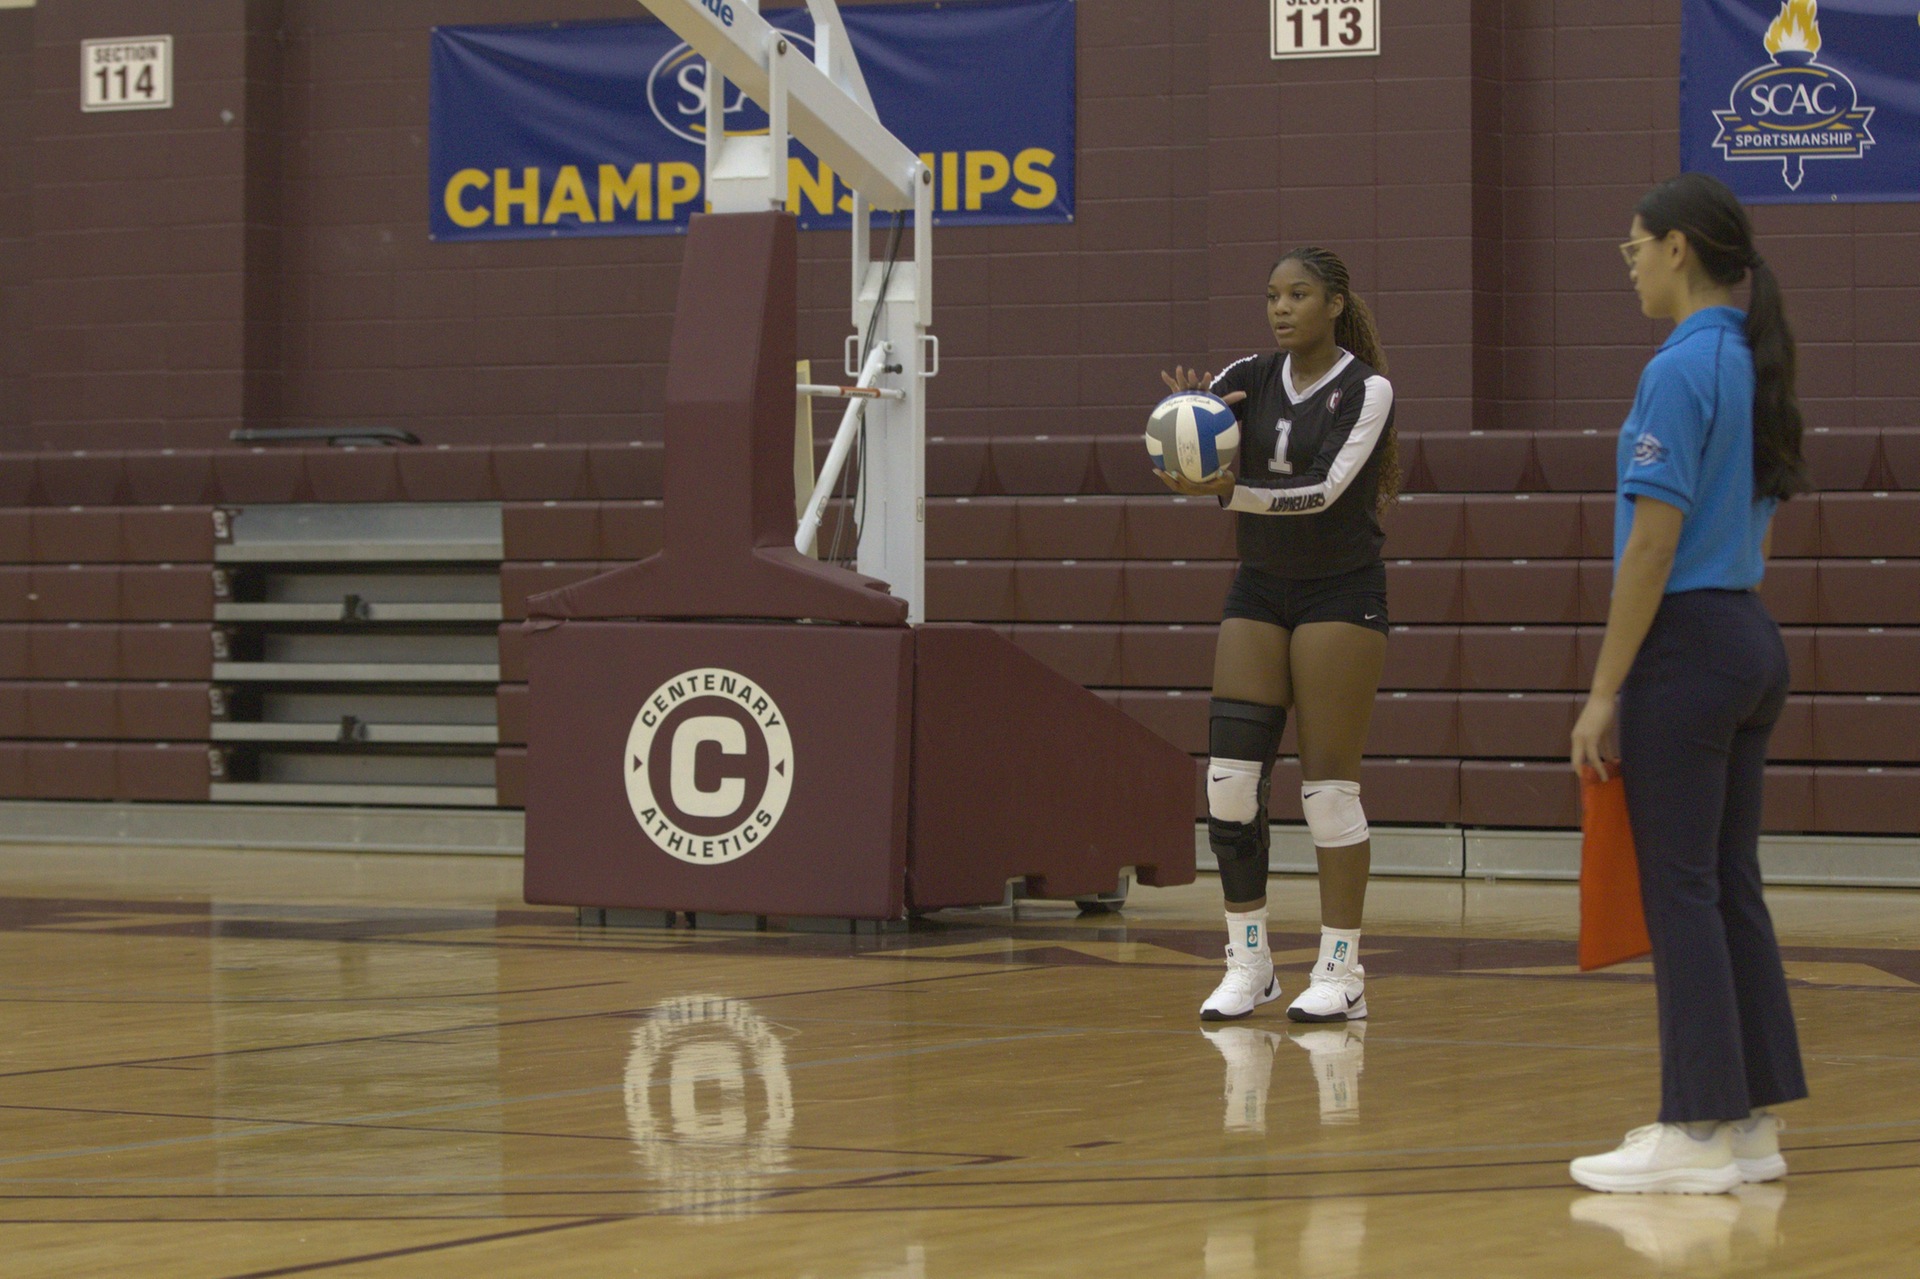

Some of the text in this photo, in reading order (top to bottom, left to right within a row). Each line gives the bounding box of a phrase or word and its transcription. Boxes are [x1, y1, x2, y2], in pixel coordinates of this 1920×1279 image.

[1286, 7, 1363, 48] 113
[94, 46, 157, 64] SECTION
[95, 65, 154, 100] 114
[1750, 82, 1837, 116] SCAC
[1735, 132, 1853, 147] SPORTSMANSHIP
[444, 147, 1059, 228] CHAMPNIPS
[1267, 418, 1293, 474] 1
[641, 674, 780, 729] CENTENARY
[670, 716, 747, 818] C
[641, 807, 772, 858] ATHLETICS
